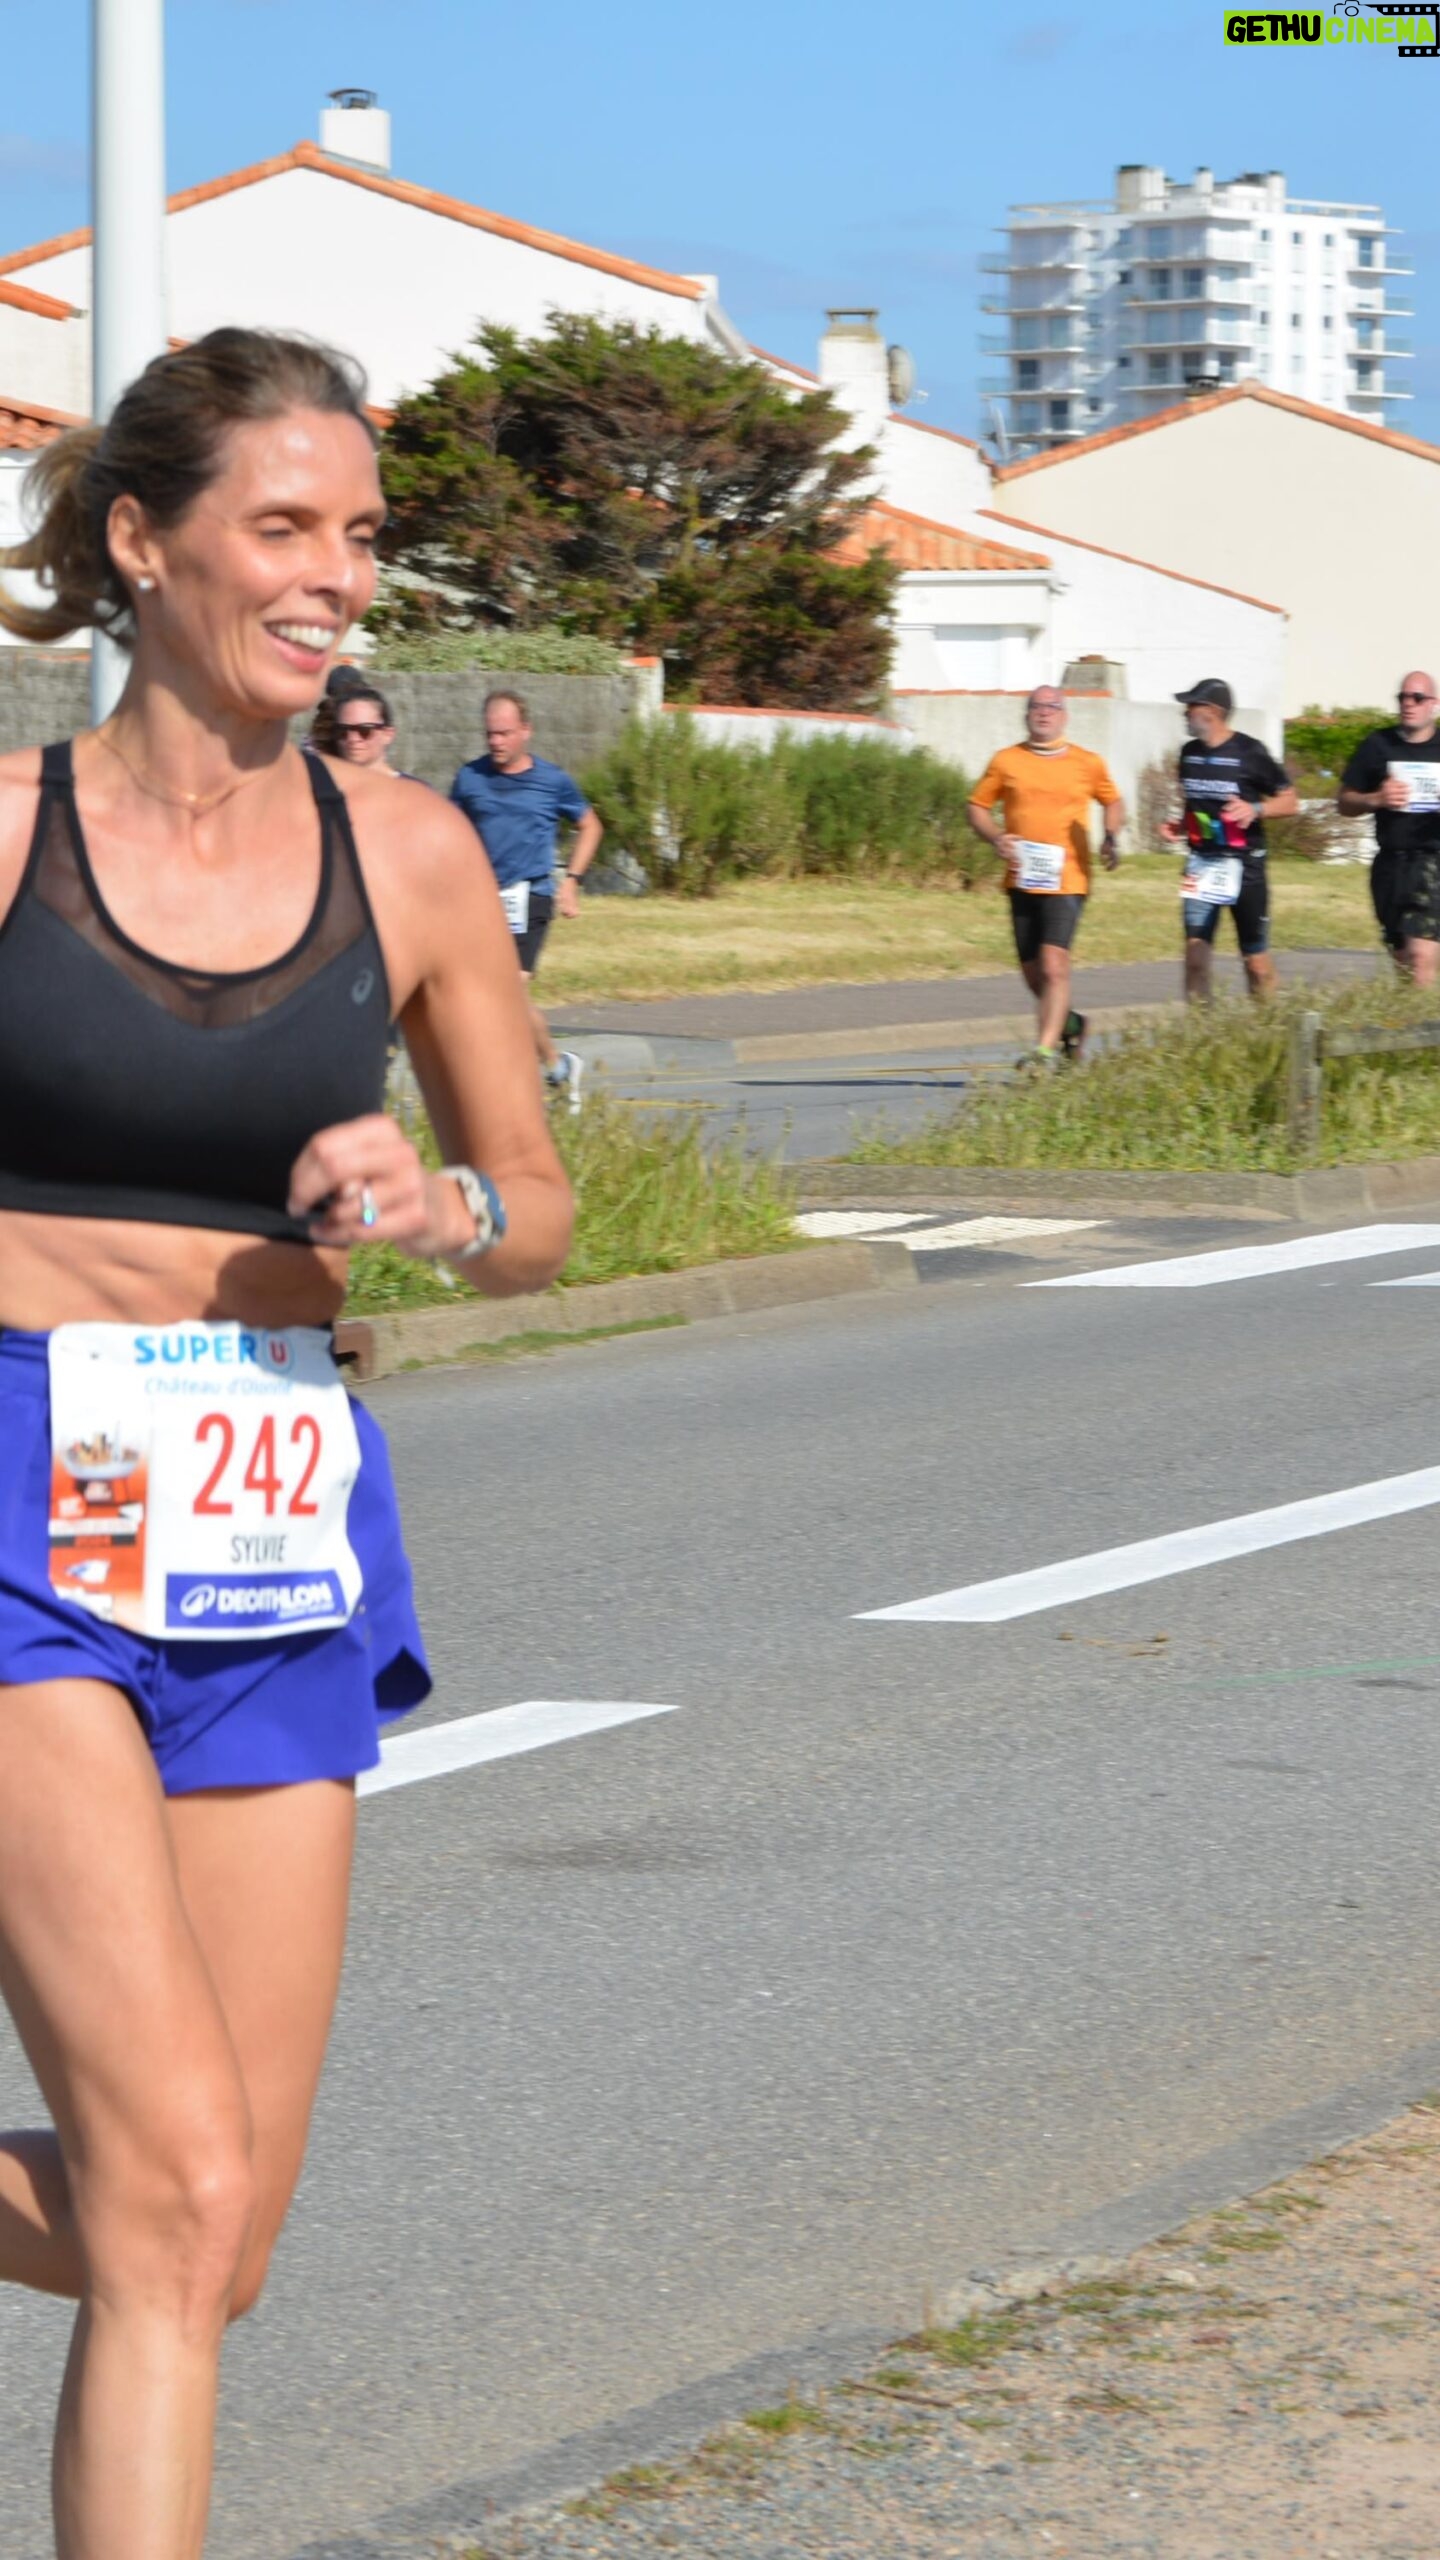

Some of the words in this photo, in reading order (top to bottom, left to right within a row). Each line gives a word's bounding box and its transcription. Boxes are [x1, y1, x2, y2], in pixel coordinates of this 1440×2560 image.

[134, 1333, 257, 1364] SUPER
[193, 1411, 321, 1517] 242
[231, 1534, 287, 1563] SYLVIE
